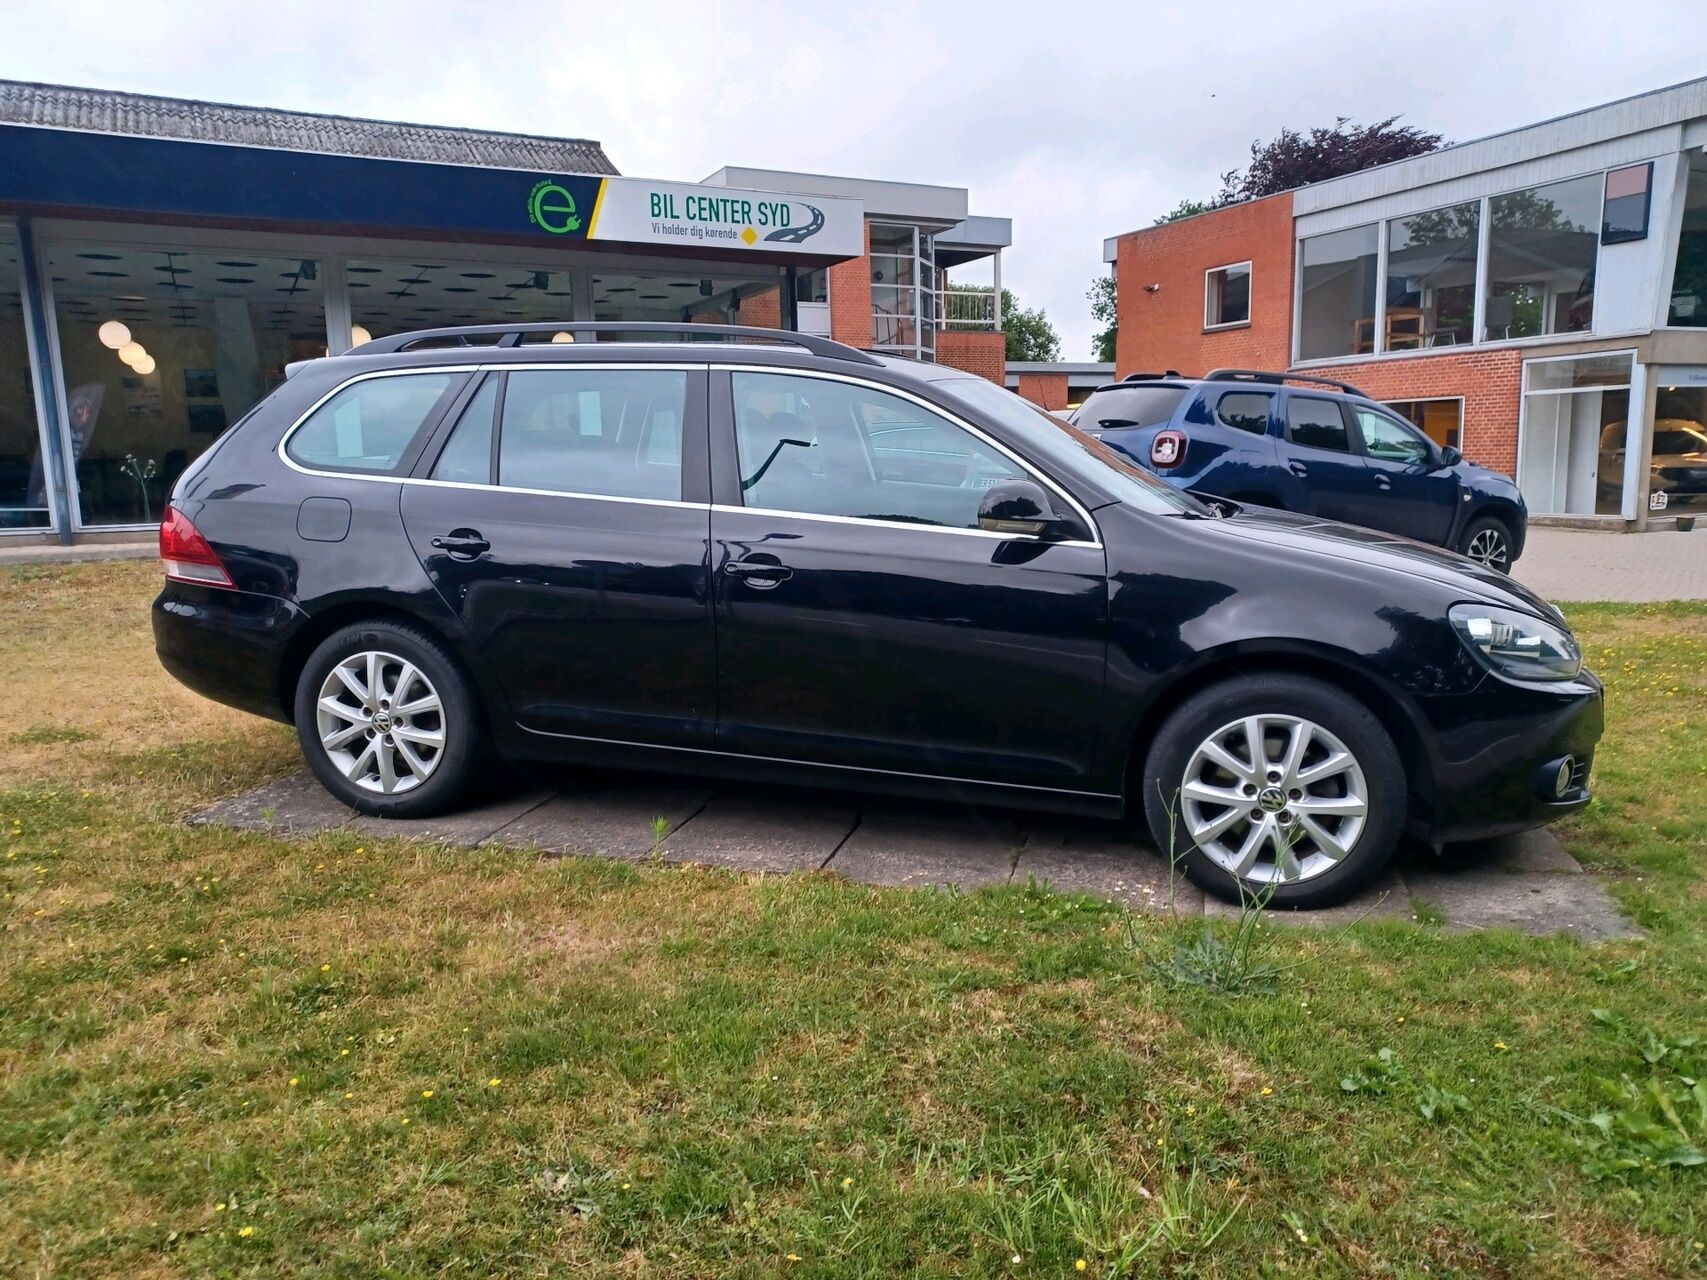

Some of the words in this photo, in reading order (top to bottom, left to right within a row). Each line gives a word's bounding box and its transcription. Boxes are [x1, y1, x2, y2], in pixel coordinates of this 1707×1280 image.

[650, 192, 680, 219] BIL
[685, 195, 752, 225] CENTER
[757, 201, 791, 228] SYD
[651, 222, 661, 234] Vi
[662, 223, 689, 236] holder
[690, 226, 703, 240] dig
[705, 228, 738, 240] kørende
